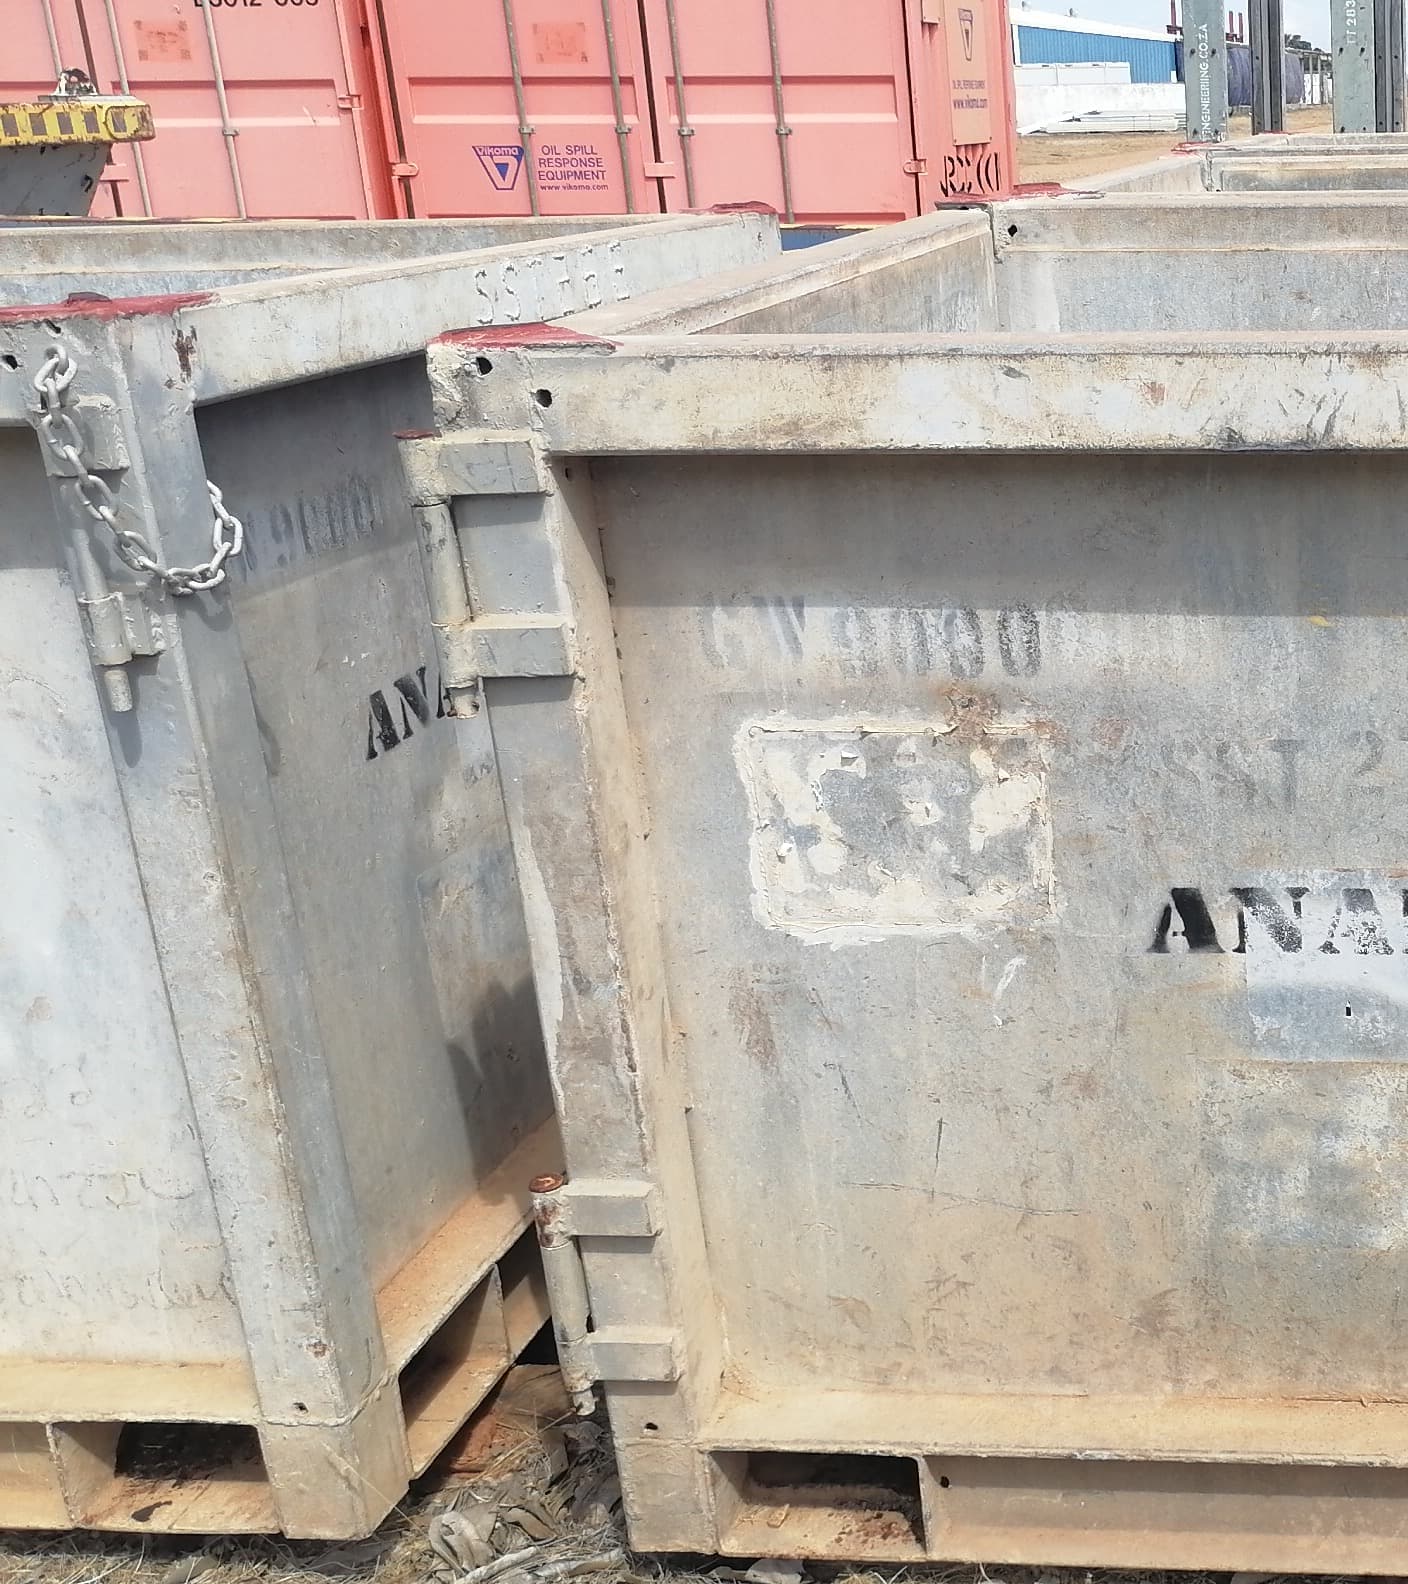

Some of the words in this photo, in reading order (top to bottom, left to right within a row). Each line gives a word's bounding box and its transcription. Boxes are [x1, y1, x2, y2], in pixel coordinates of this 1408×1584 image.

[541, 145, 561, 156] OIL
[565, 145, 598, 156] SPILL
[538, 157, 604, 168] RESPONSE
[538, 170, 607, 181] EQUIPMENT
[1160, 737, 1307, 810] SST
